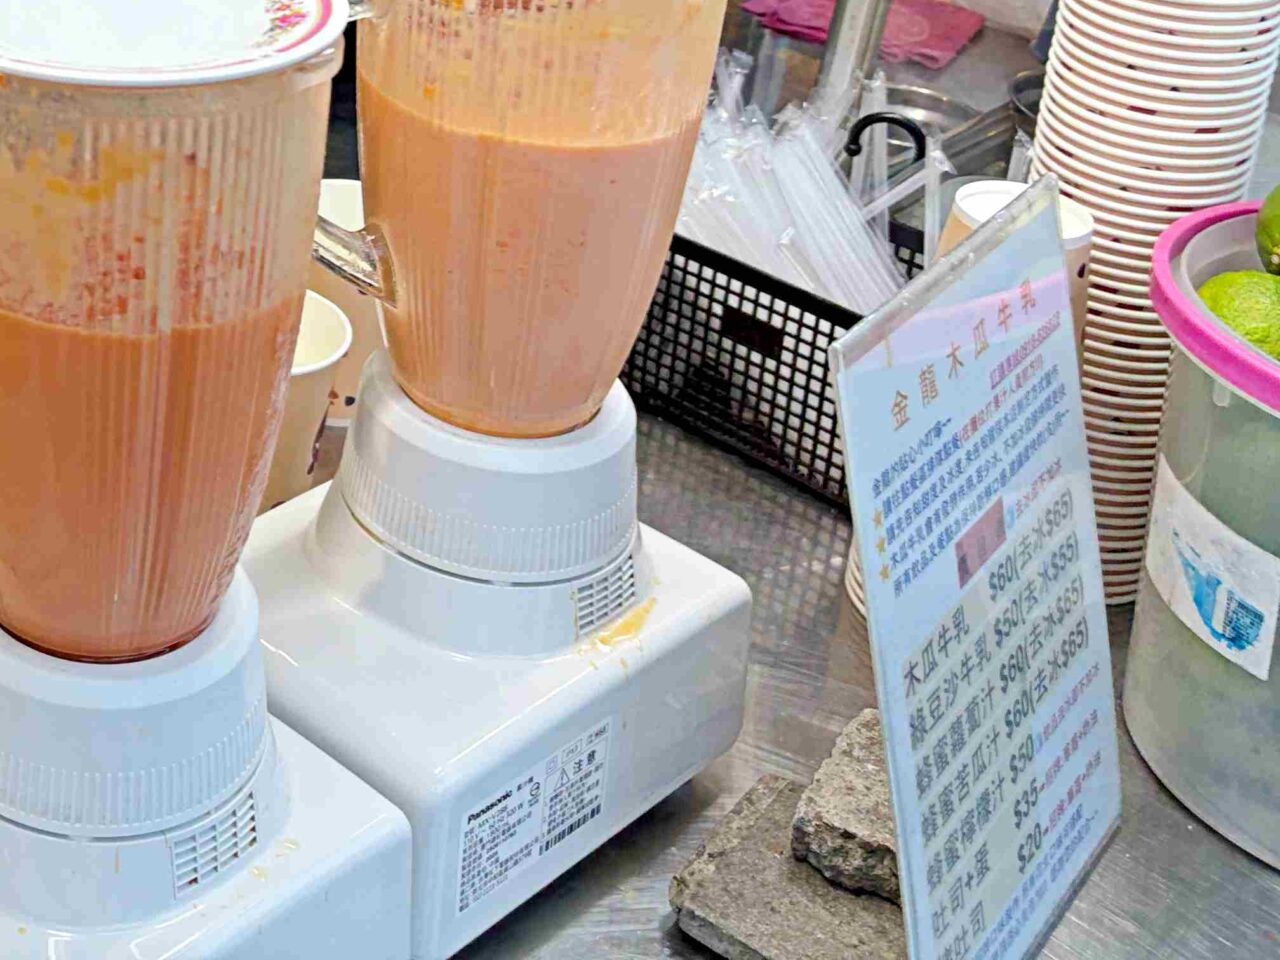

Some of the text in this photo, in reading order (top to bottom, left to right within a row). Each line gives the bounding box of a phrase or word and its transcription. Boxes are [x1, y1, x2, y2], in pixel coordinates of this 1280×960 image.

[889, 272, 1036, 433] 金龍木瓜牛乳
[902, 600, 969, 703] 木瓜牛乳
[908, 627, 991, 753] 綠豆沙牛乳
[467, 790, 513, 825] Panasonic
[920, 723, 1001, 850] 蜂蜜苦瓜汁
[925, 766, 1006, 897] 蜂蜜檸檬汁
[1008, 730, 1034, 787] $50
[1015, 815, 1042, 879] $20
[932, 837, 990, 943] 吐司+蛋
[1012, 773, 1039, 835] $35
